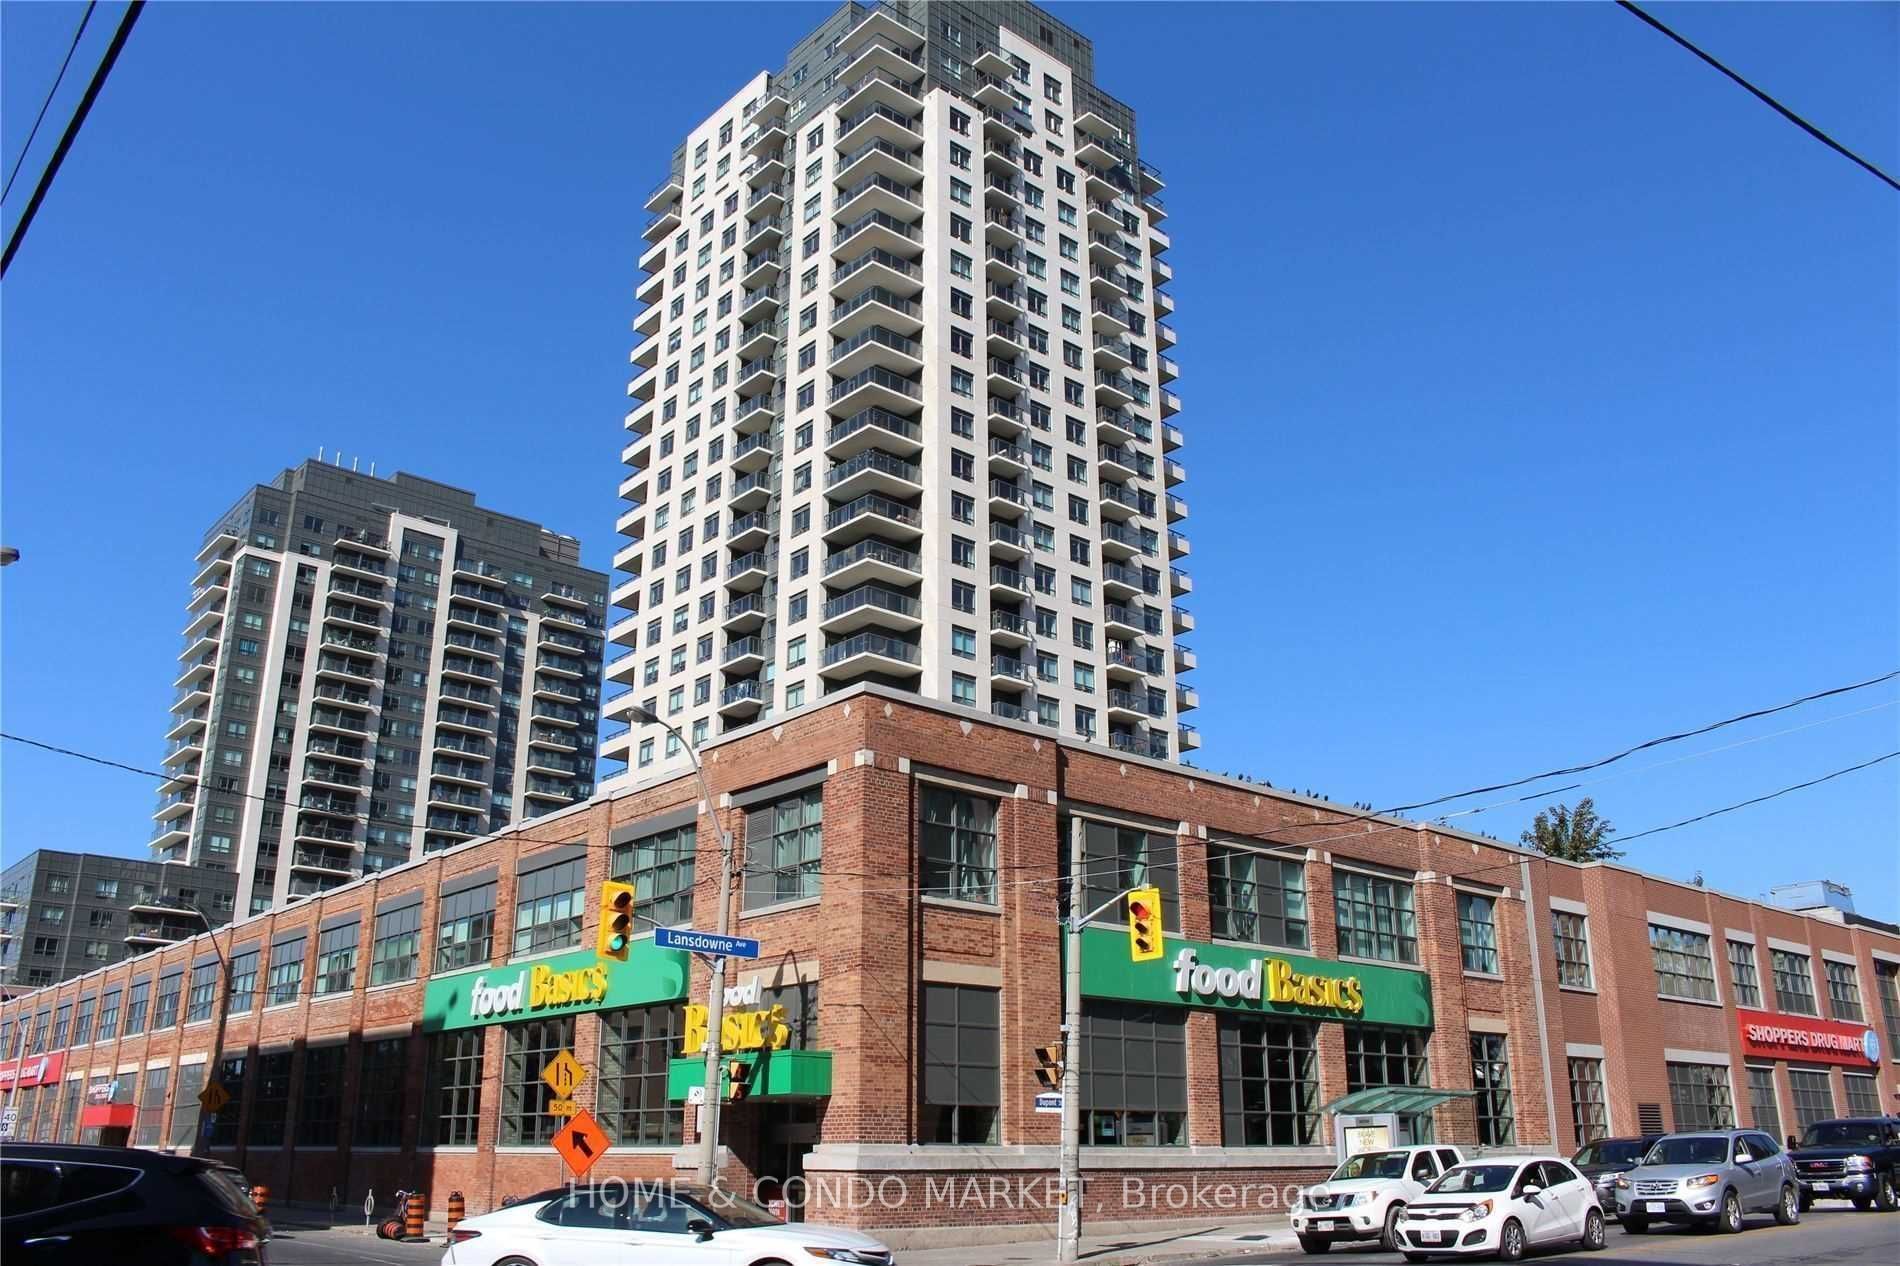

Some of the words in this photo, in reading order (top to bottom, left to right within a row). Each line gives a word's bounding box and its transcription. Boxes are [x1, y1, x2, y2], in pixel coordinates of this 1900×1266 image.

[667, 931, 733, 951] Lansdowne
[735, 940, 747, 949] Ave
[1173, 948, 1263, 1000] food
[471, 970, 529, 1017] food
[1748, 1023, 1809, 1047] SHOPPERS
[1809, 1031, 1838, 1049] DRUG
[4, 1113, 17, 1122] 40
[553, 1103, 563, 1112] 50
